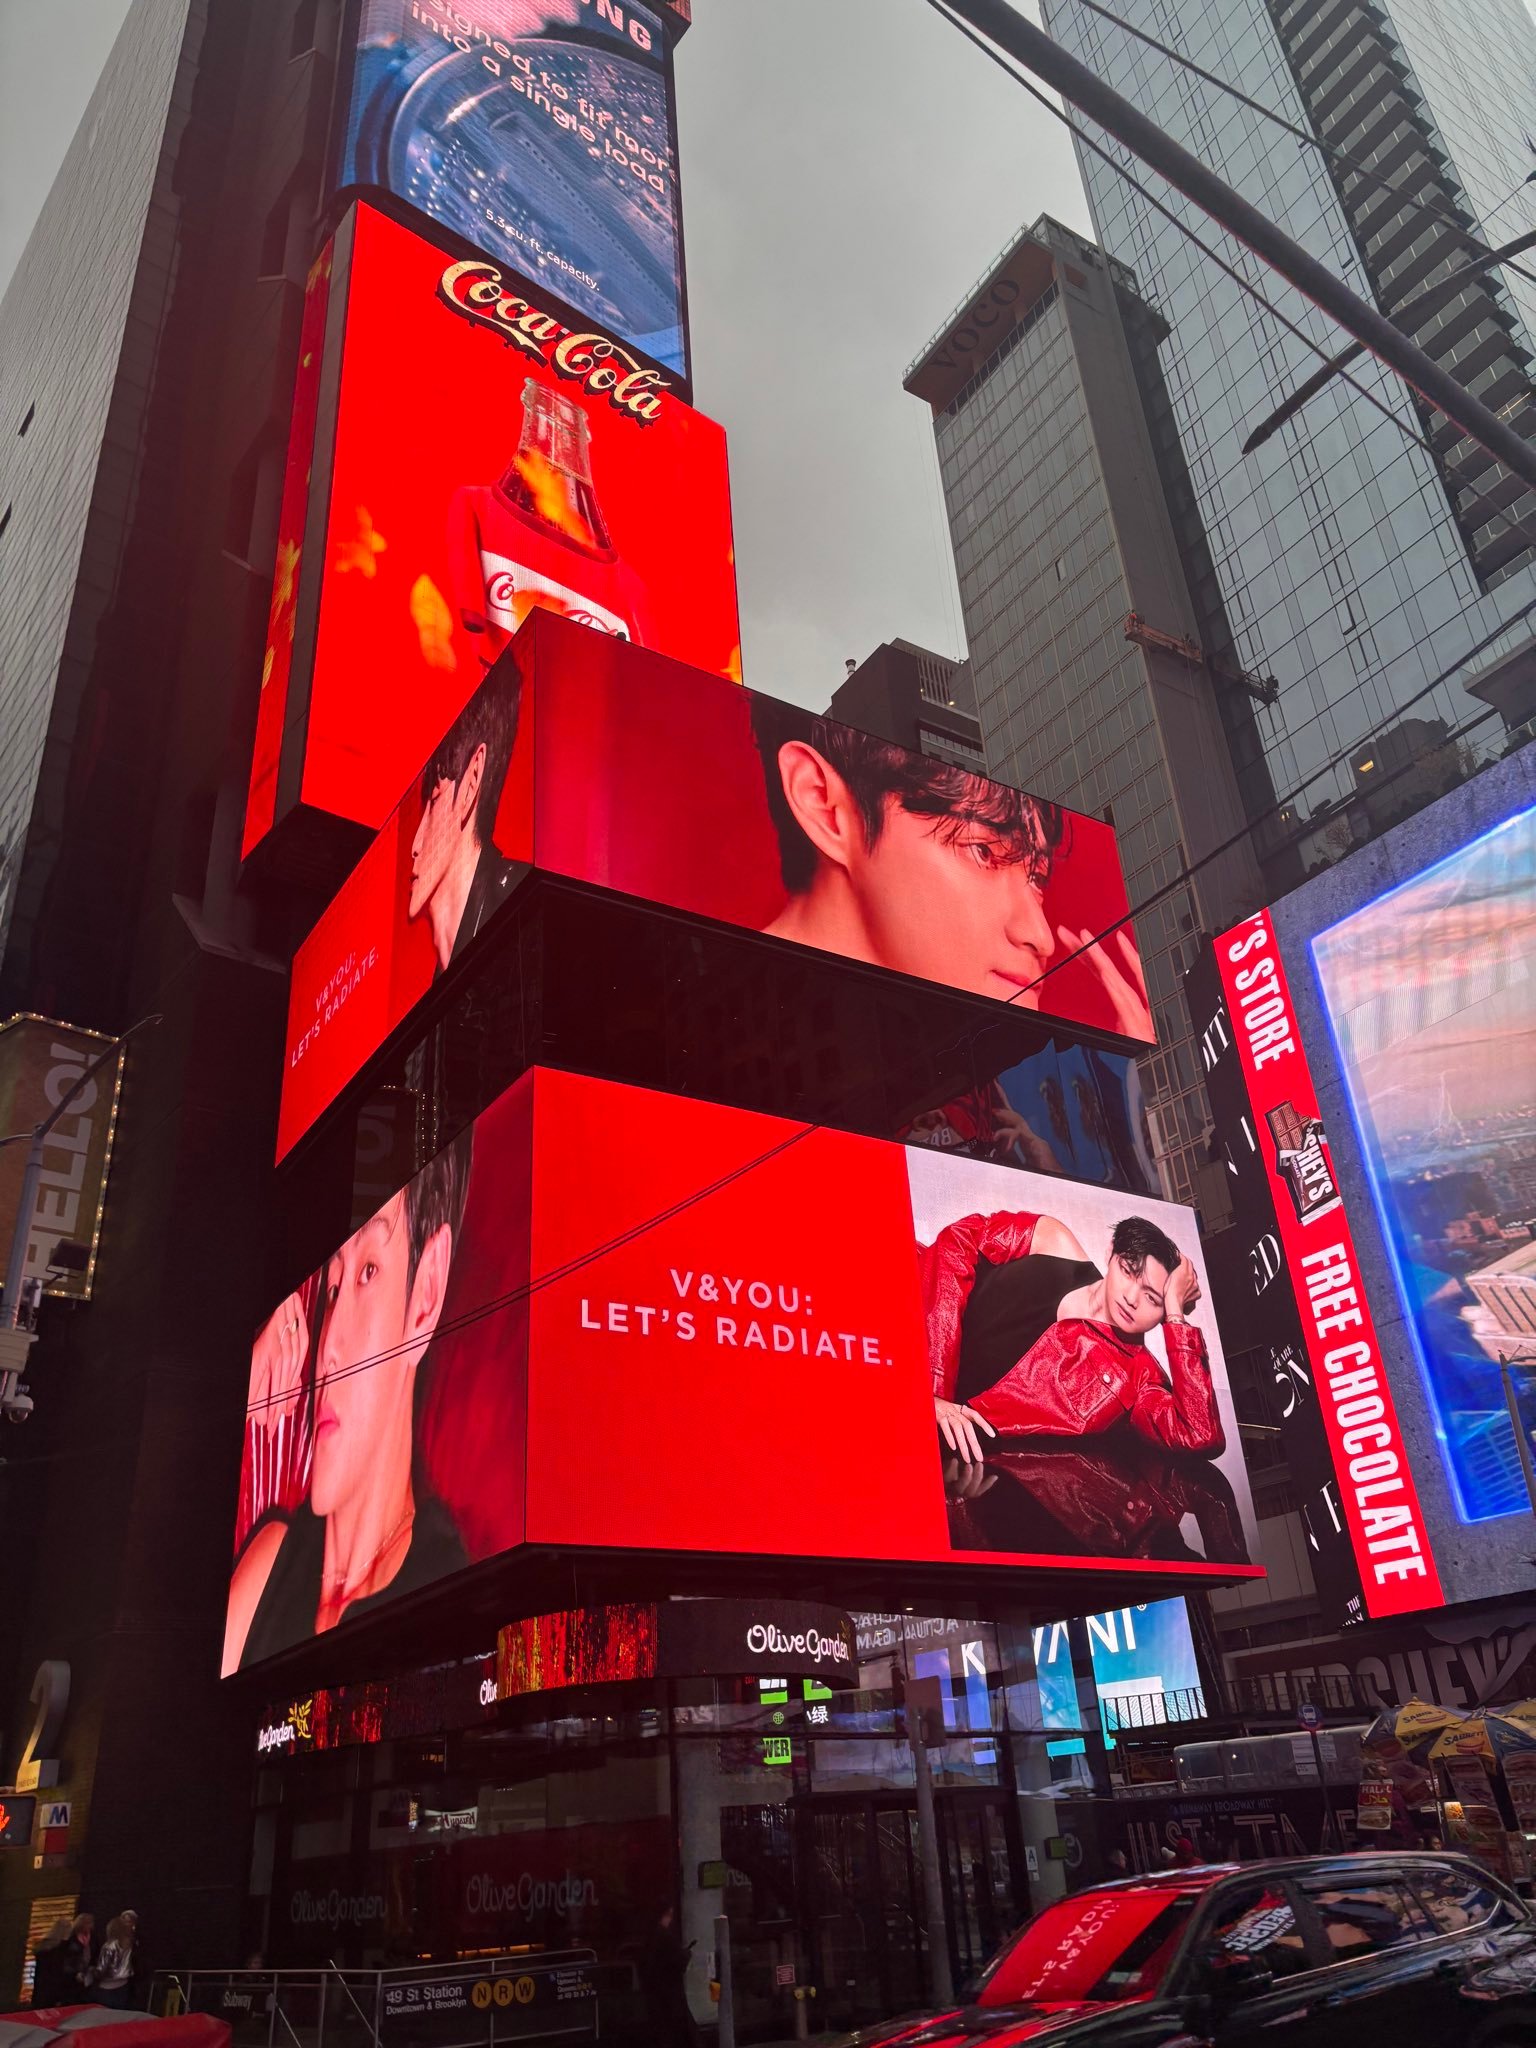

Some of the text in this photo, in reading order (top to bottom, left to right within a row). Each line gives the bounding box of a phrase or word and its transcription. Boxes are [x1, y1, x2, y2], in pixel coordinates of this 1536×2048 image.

[412, 2, 665, 195] into a single load
[539, 71, 569, 100] to
[485, 208, 505, 229] 5.3
[547, 250, 601, 291] capacity.
[291, 945, 379, 1068] LET'S RADIATE.
[315, 951, 357, 1012] V&YOU:
[1235, 957, 1296, 1071] STORE
[670, 1268, 813, 1316] V&YOU:
[581, 1298, 893, 1366] LET'S RADIATE.
[1301, 1242, 1427, 1585] FREE CHOCOLATE
[746, 1624, 850, 1664] Olive Garden
[15, 1659, 71, 1793] 2
[466, 1868, 599, 1924] Olive Garden
[223, 1991, 254, 2010] Subway
[386, 1985, 463, 2004] 49 St Station
[386, 2004, 425, 2015] Downtown
[435, 1999, 467, 2011] Brooklyn
